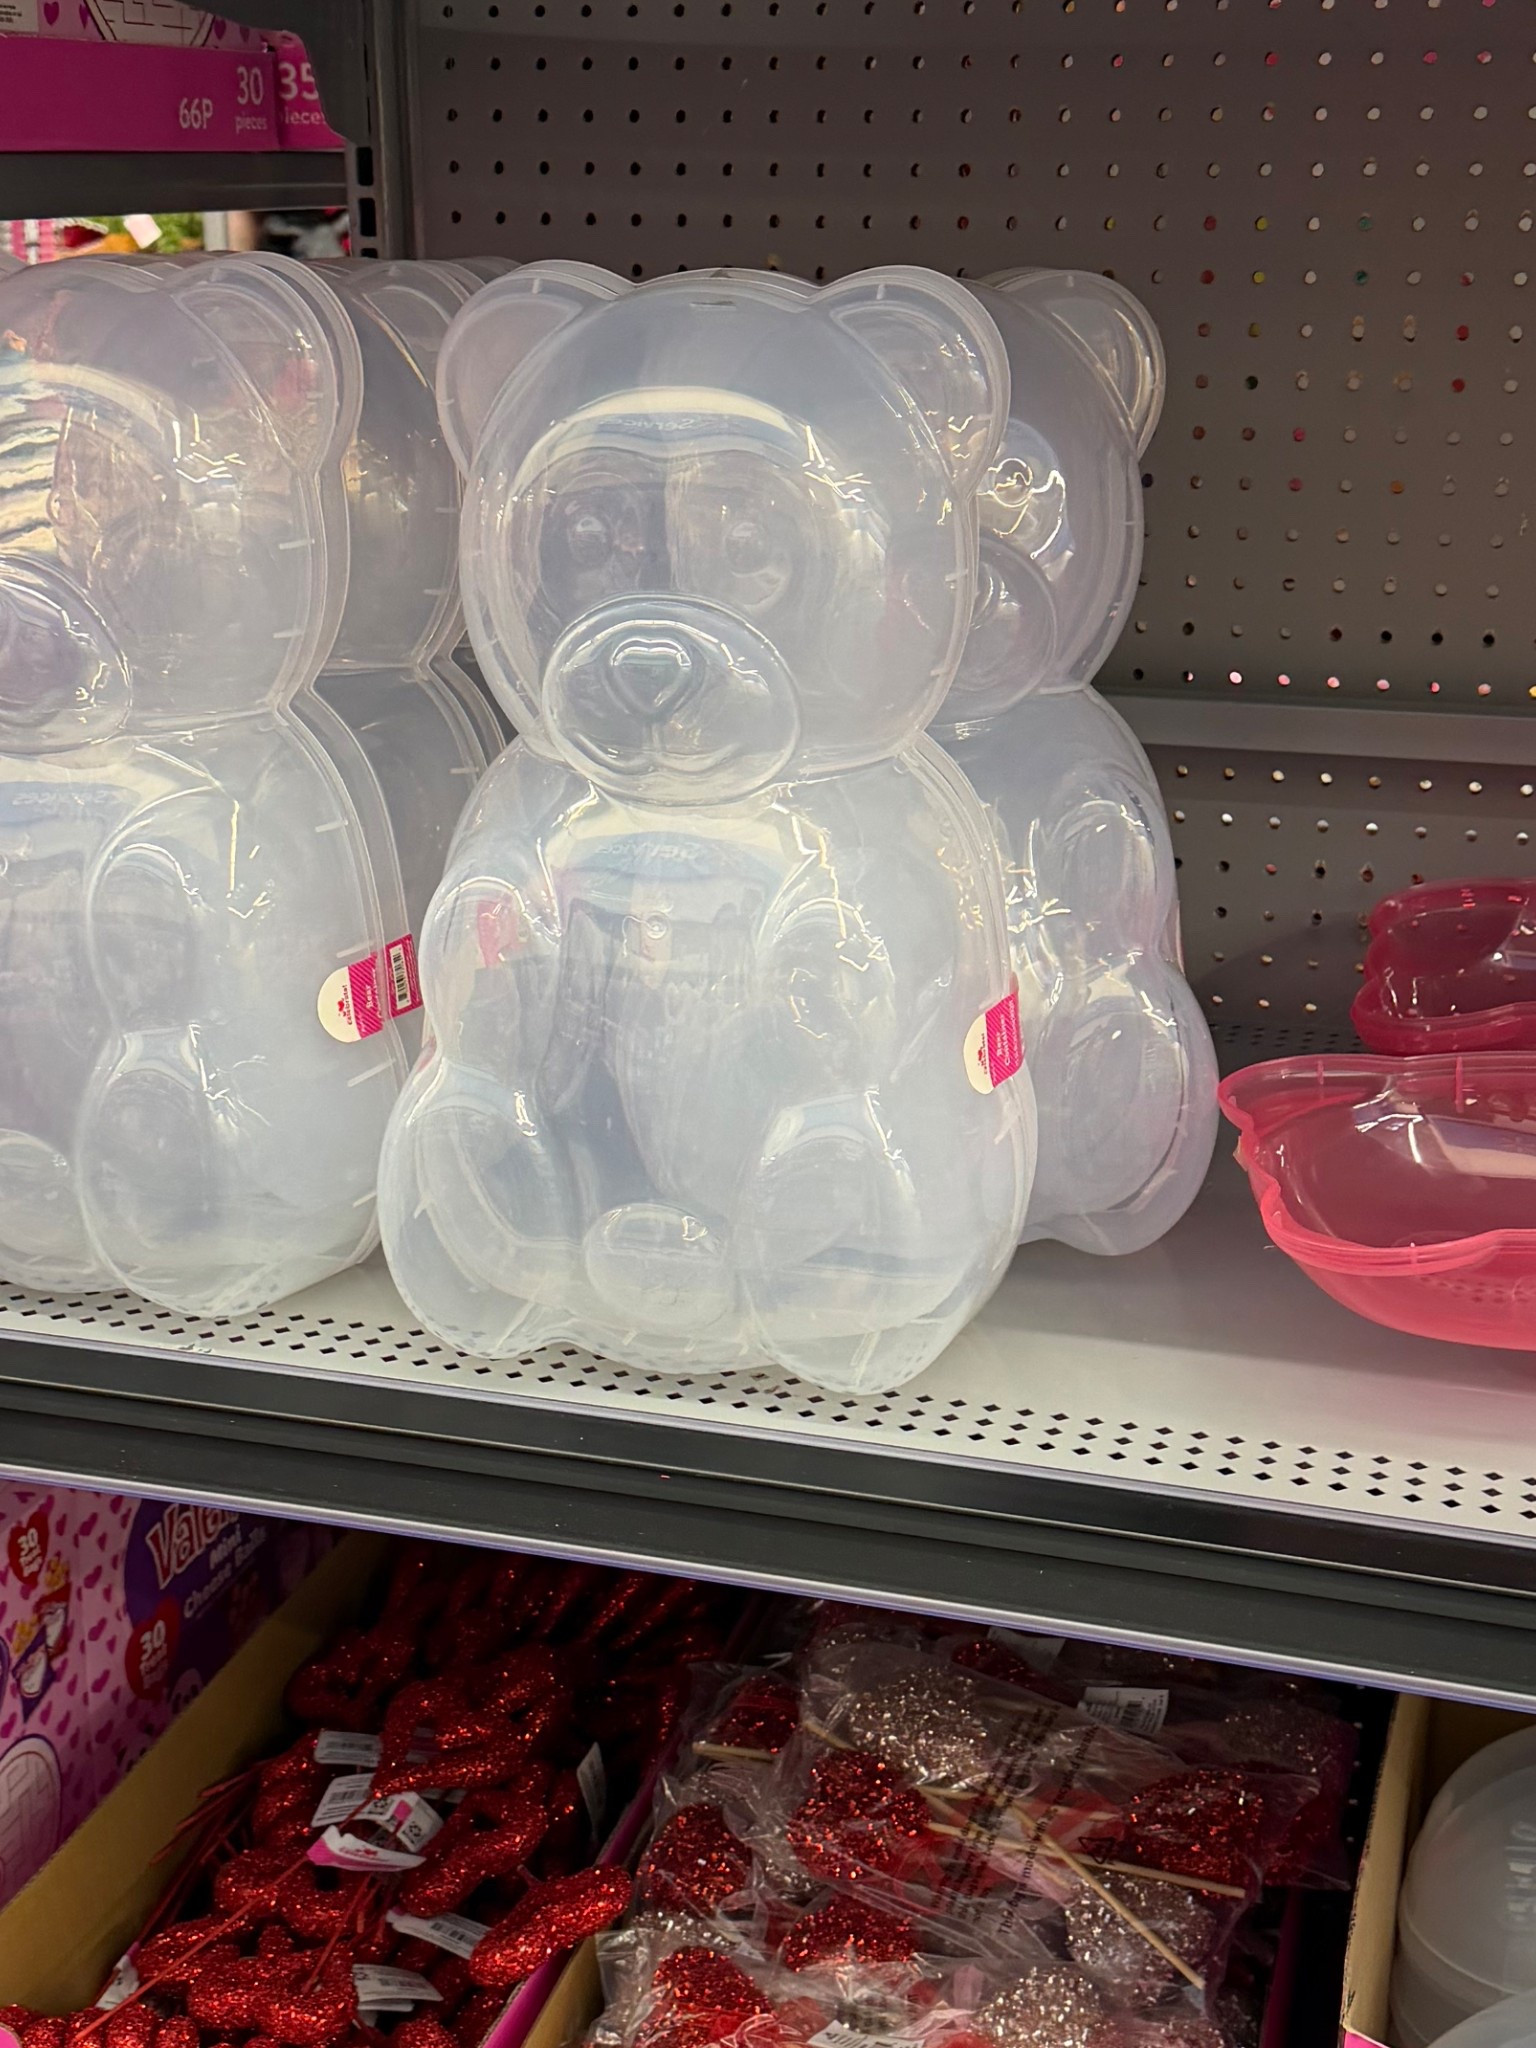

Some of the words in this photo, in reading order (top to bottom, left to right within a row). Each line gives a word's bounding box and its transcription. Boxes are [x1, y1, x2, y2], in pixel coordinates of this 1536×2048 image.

[236, 66, 264, 105] 30
[278, 62, 319, 101] 35
[179, 98, 213, 129] 66P
[235, 111, 267, 134] pieces
[281, 107, 326, 125] iece
[17, 1527, 38, 1556] 30
[140, 1619, 166, 1661] 30
[1023, 1844, 1038, 1878] made
